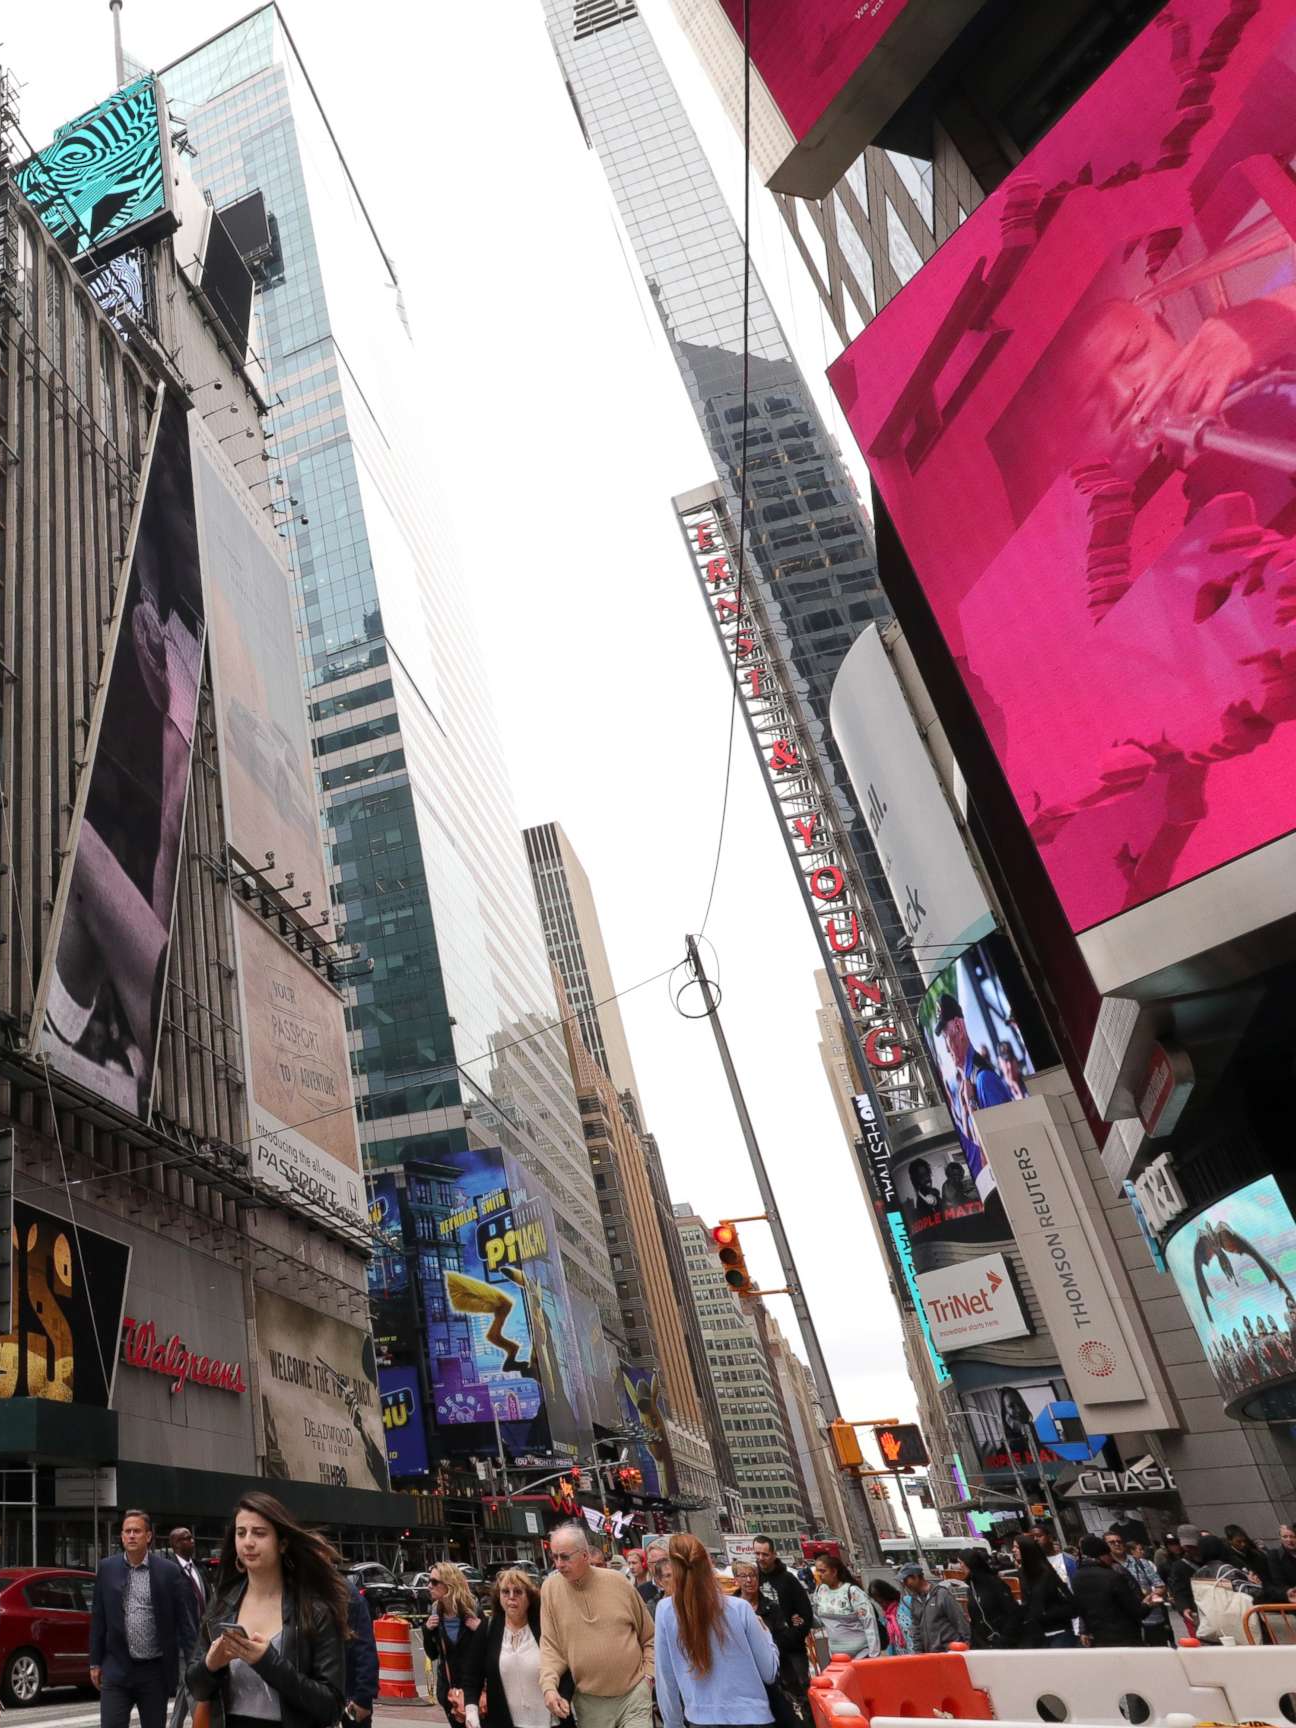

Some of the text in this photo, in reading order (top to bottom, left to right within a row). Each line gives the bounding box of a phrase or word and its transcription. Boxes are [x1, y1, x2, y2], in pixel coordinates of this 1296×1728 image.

[697, 523, 766, 698] ERNST
[794, 812, 904, 1070] YOUNG
[271, 1014, 320, 1060] PASSPORT
[255, 1119, 299, 1164] Introducing
[298, 1149, 311, 1168] the
[257, 1145, 338, 1204] PASSPORT
[481, 1193, 507, 1216] SMITH
[1014, 1147, 1091, 1329] THOMSON REUTERS
[927, 1288, 994, 1323] TriNet
[122, 1317, 247, 1393] Walgreens
[269, 1349, 313, 1389] WELCOME
[313, 1365, 330, 1395] THE
[304, 1417, 353, 1448] DEADWOOD
[1077, 1467, 1177, 1495] CHASE
